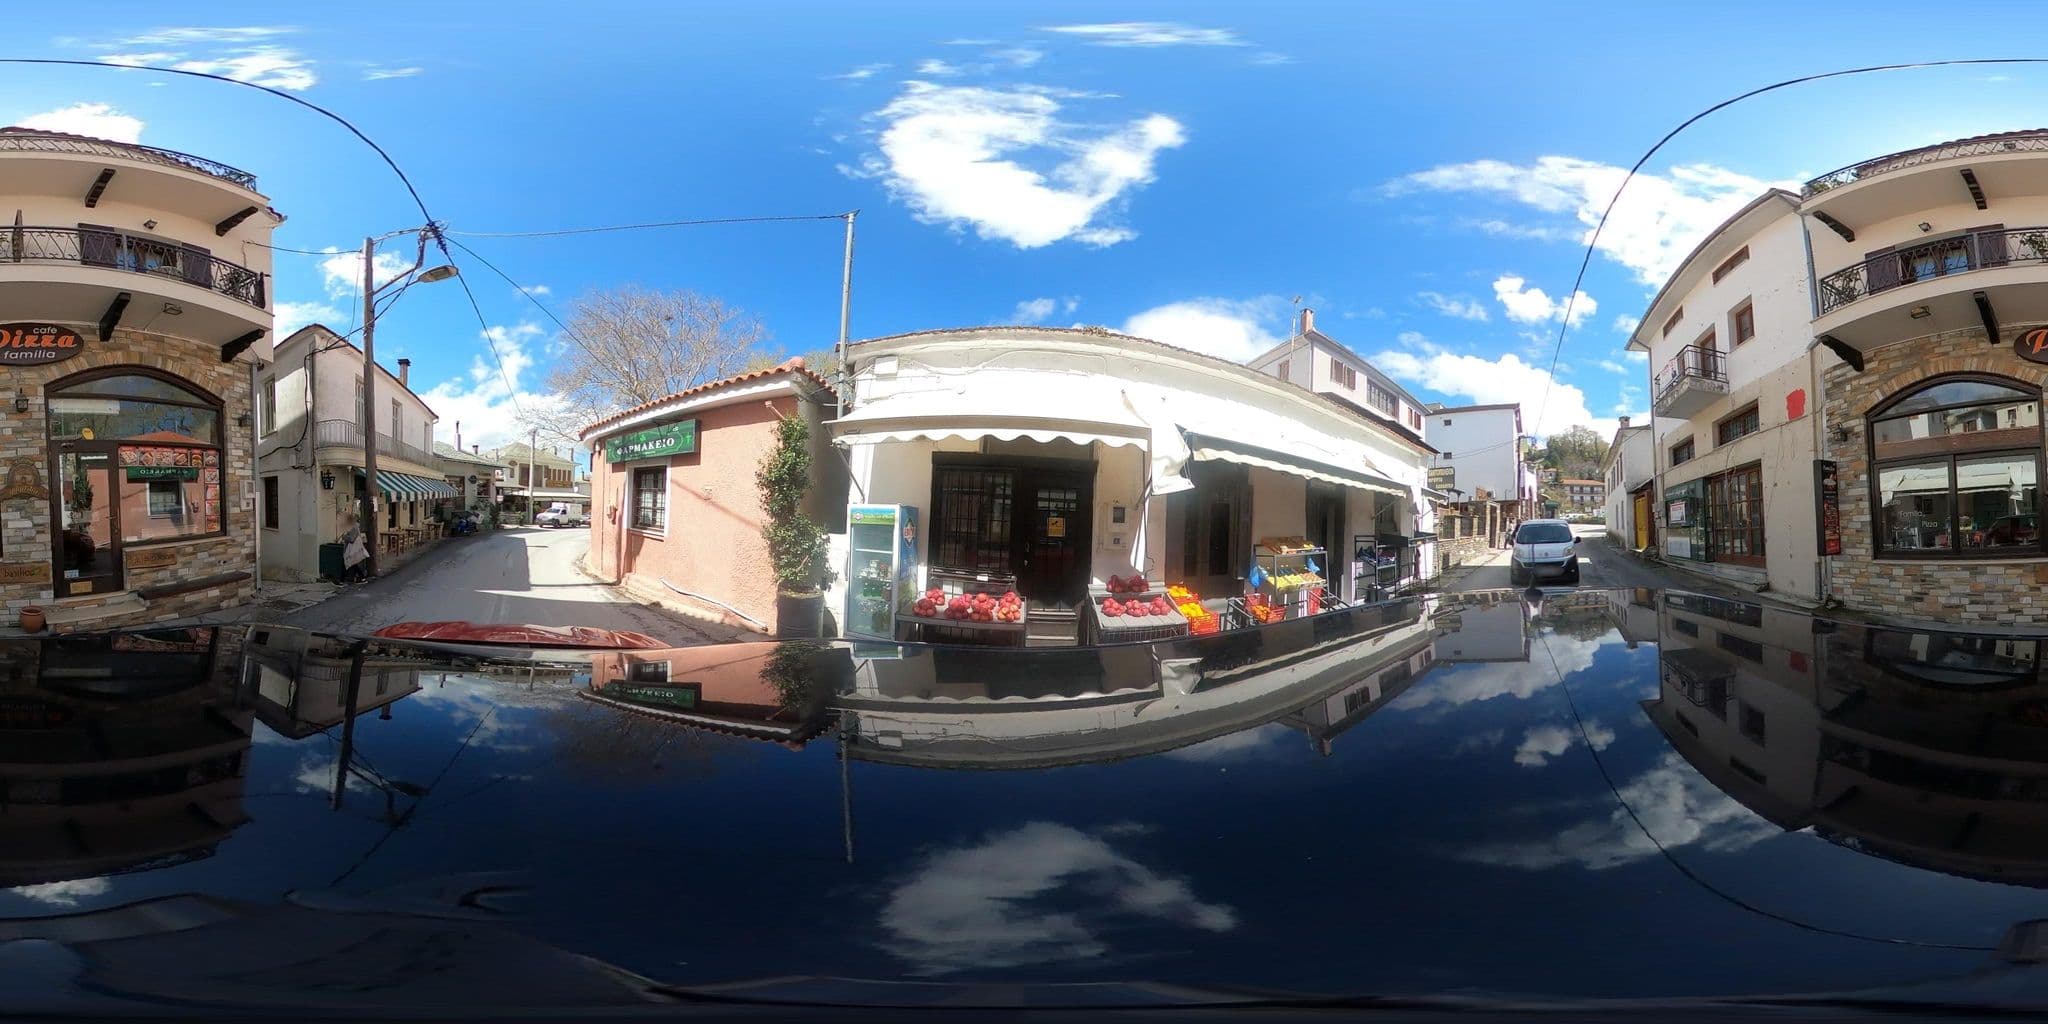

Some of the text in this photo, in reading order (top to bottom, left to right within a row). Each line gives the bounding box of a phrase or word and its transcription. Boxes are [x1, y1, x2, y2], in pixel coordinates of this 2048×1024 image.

[33, 326, 58, 334] cafe
[4, 350, 56, 359] familia
[616, 437, 675, 455] ΦΑΡΜΑΚΕΙΟ
